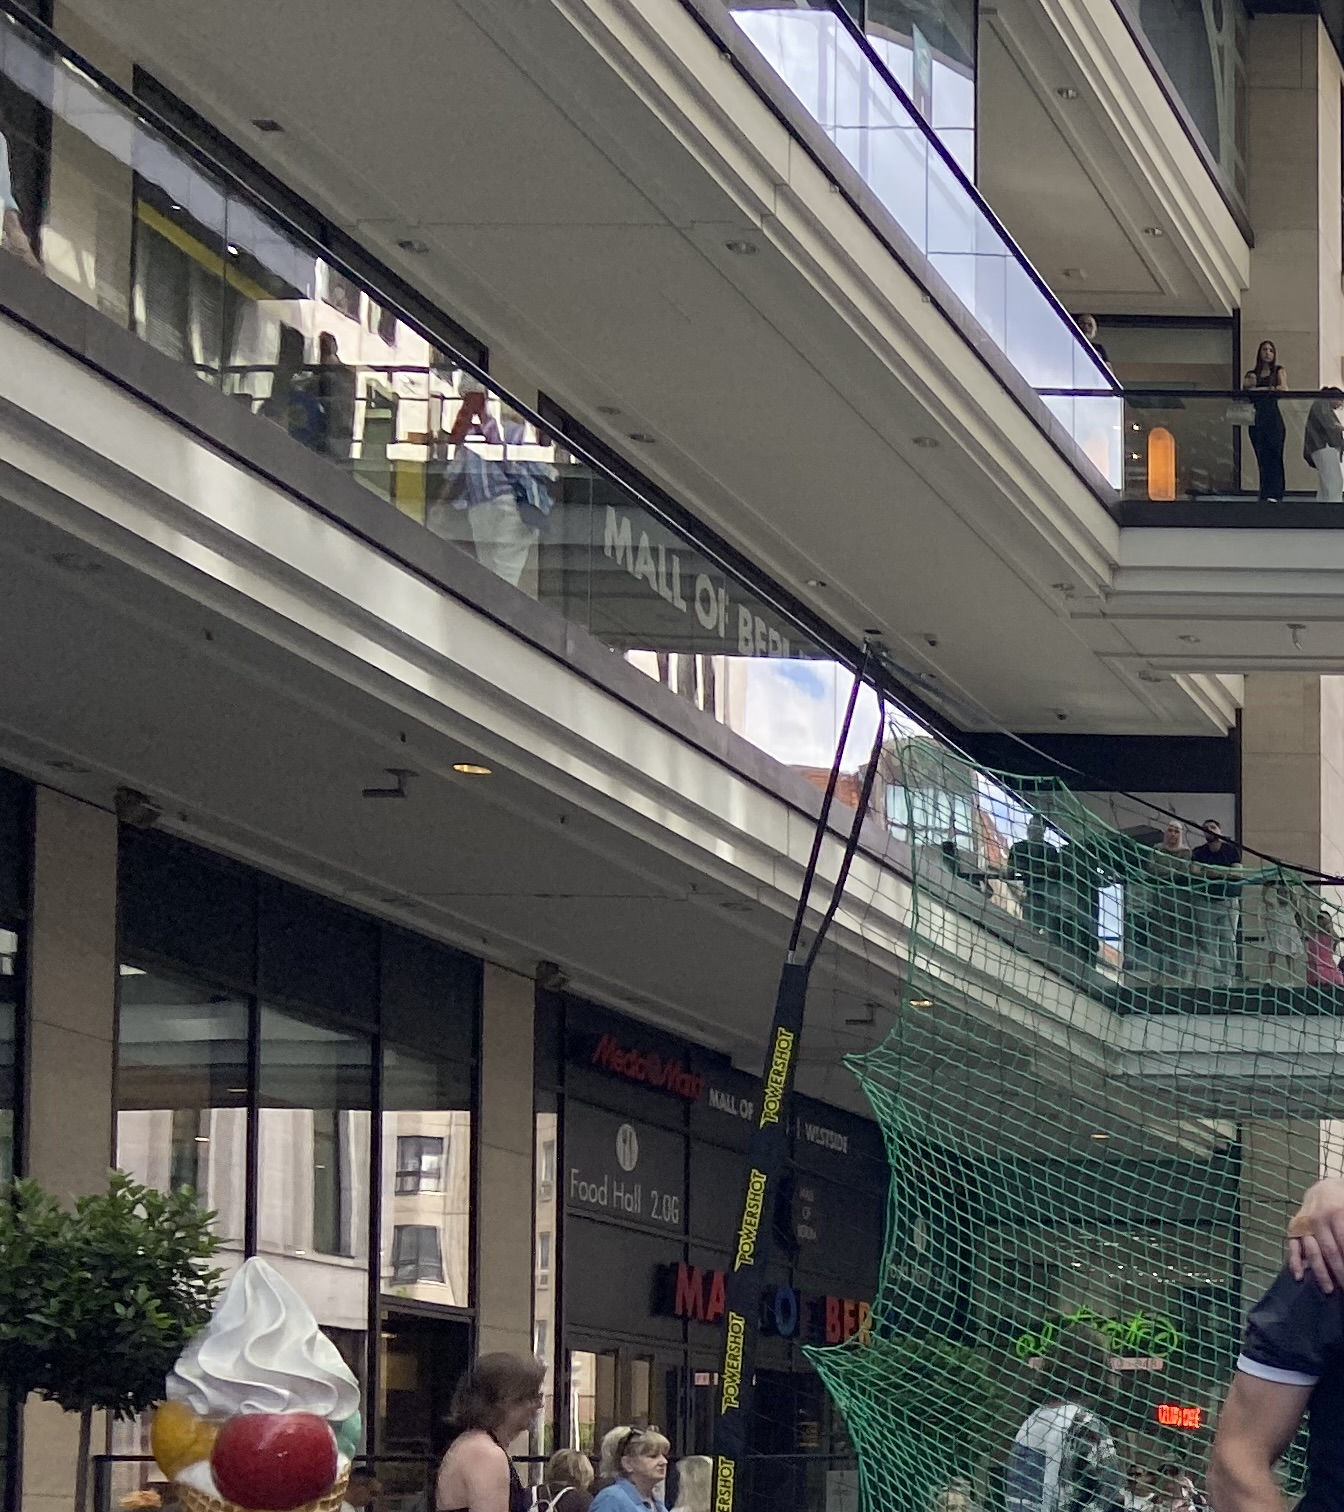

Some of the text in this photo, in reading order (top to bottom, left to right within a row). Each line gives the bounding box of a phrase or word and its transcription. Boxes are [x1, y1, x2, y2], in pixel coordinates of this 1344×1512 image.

[604, 504, 687, 613] MALL
[708, 1088, 737, 1116] MALL
[760, 1027, 794, 1130] POWERSHOT
[570, 1168, 608, 1207] Food
[613, 1180, 641, 1214] Hall
[734, 1169, 767, 1273] POWERSHOT
[721, 1311, 745, 1416] POWERSHOT
